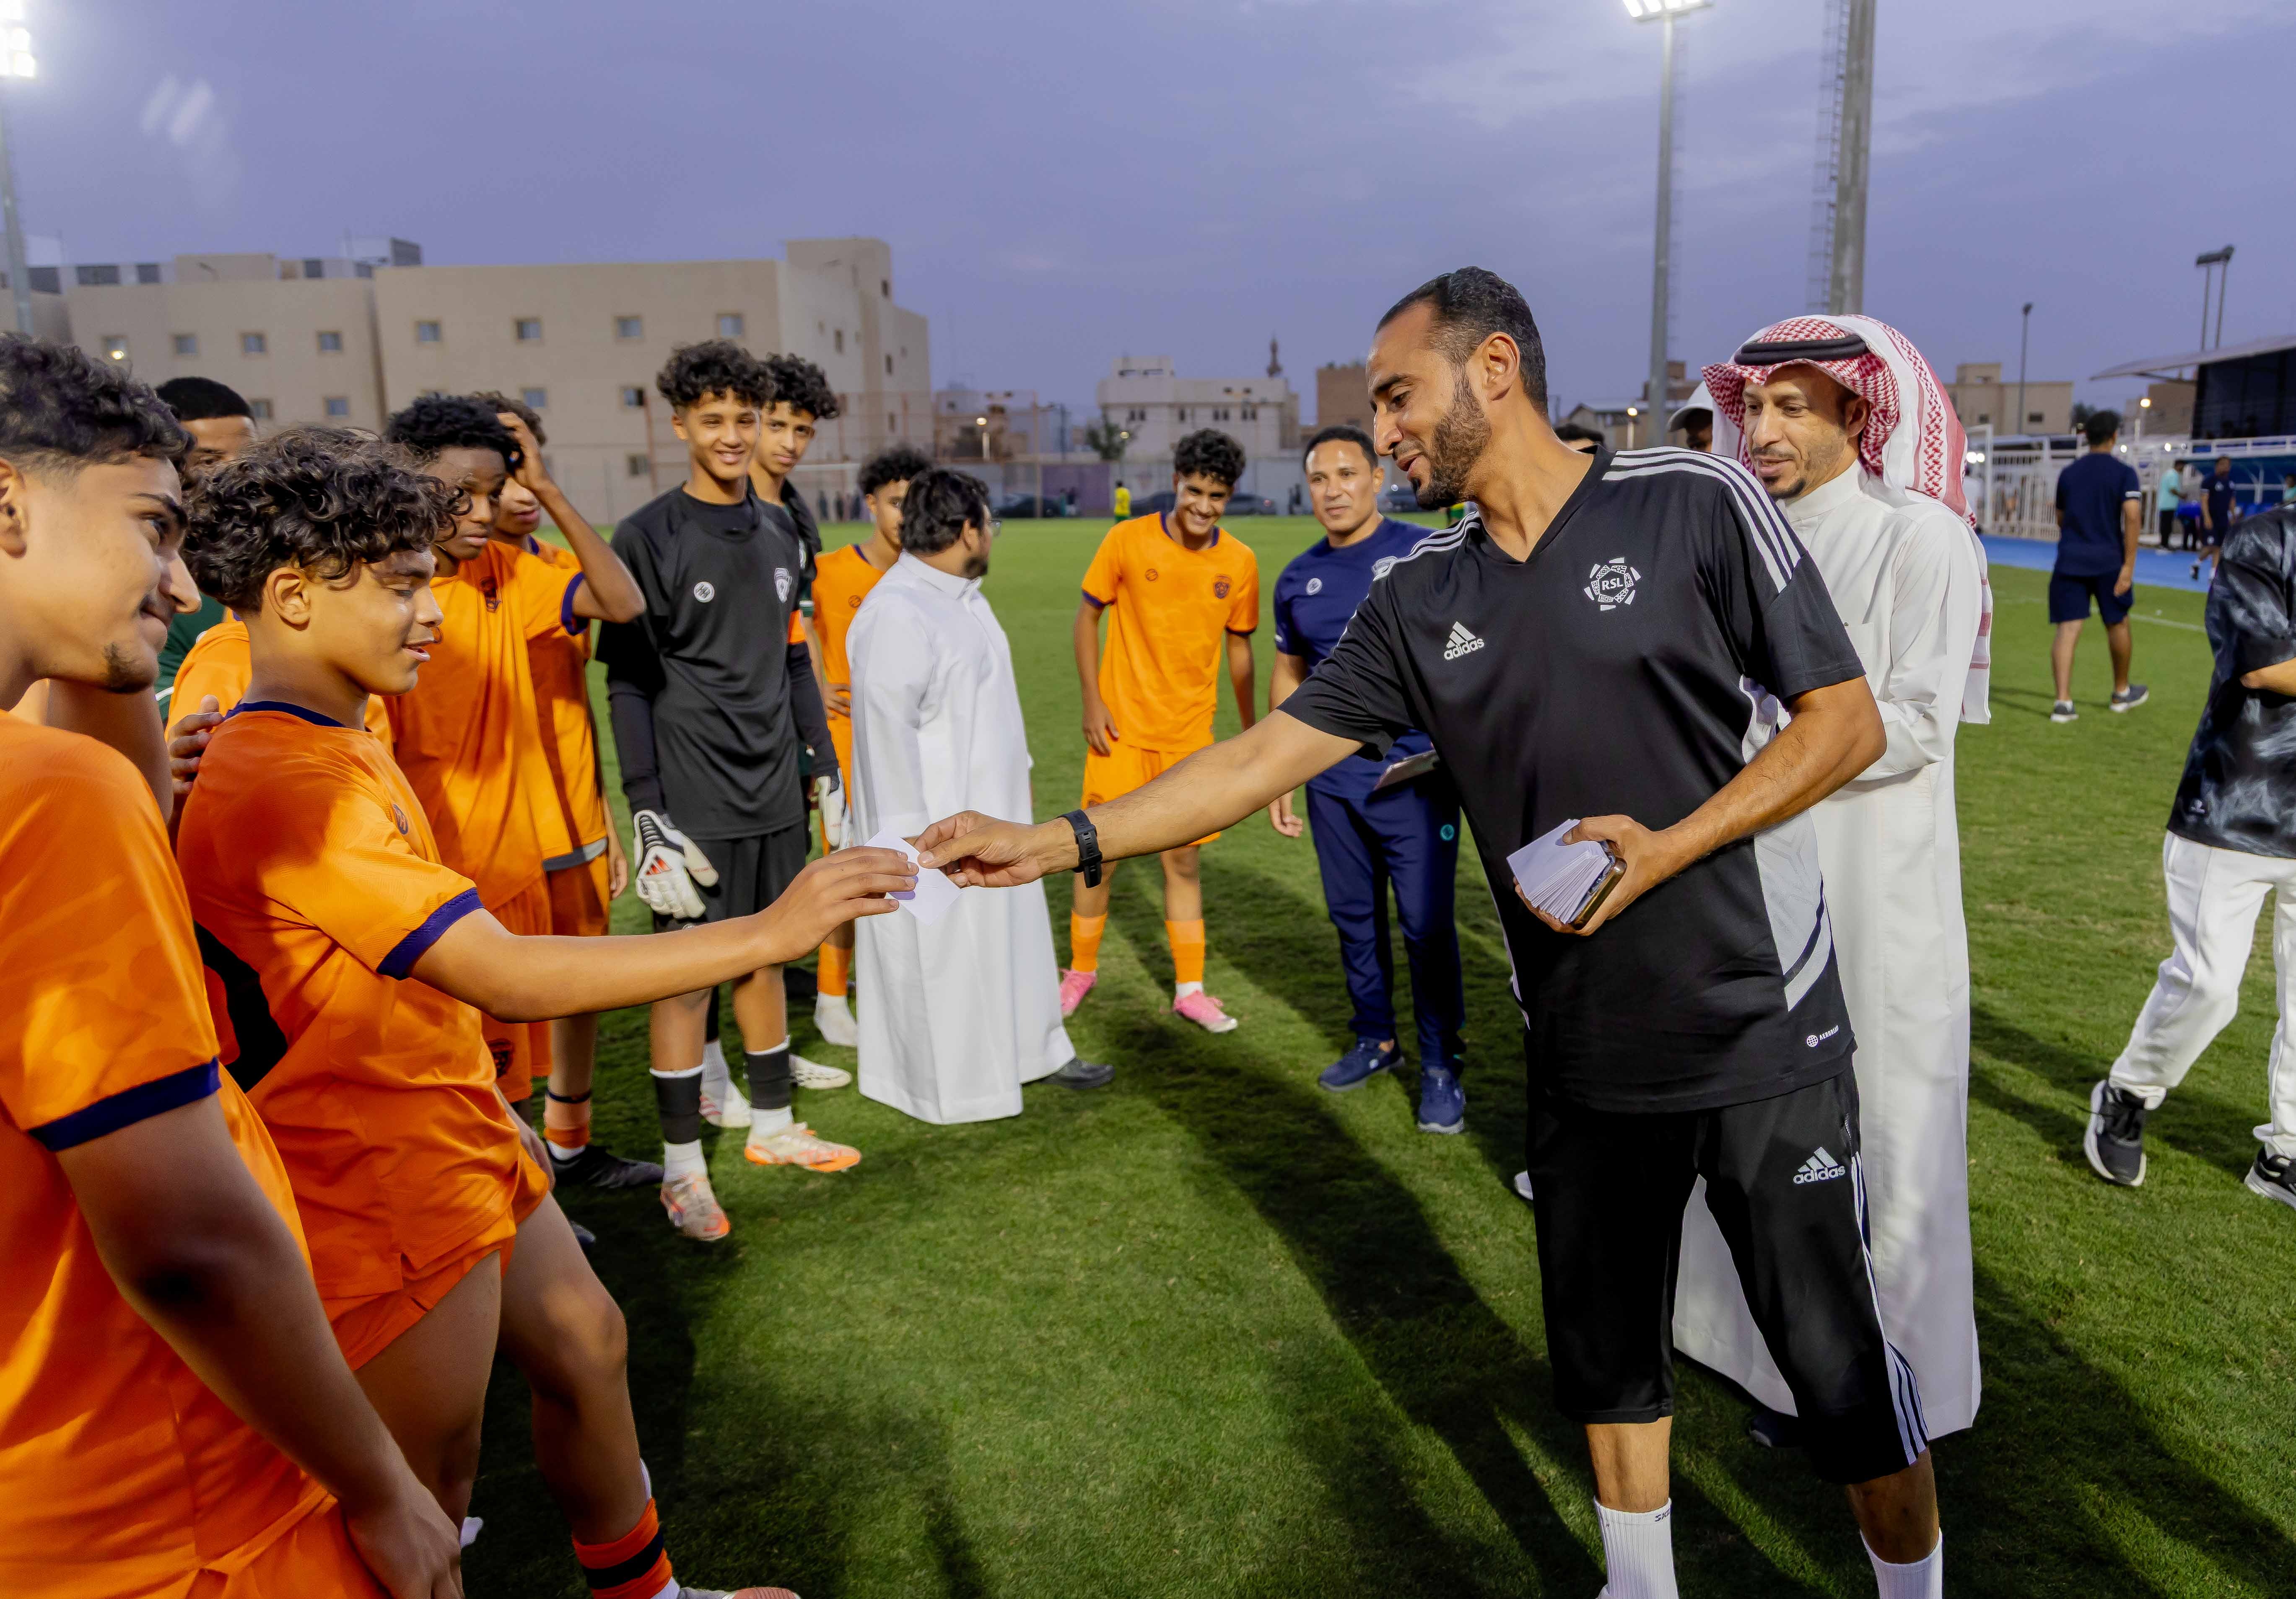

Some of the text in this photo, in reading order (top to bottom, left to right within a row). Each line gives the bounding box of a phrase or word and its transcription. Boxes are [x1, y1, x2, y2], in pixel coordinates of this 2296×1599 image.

[1602, 578, 1624, 591] RSL
[1443, 638, 1484, 660] adidas
[1793, 1166, 1845, 1184] adidas
